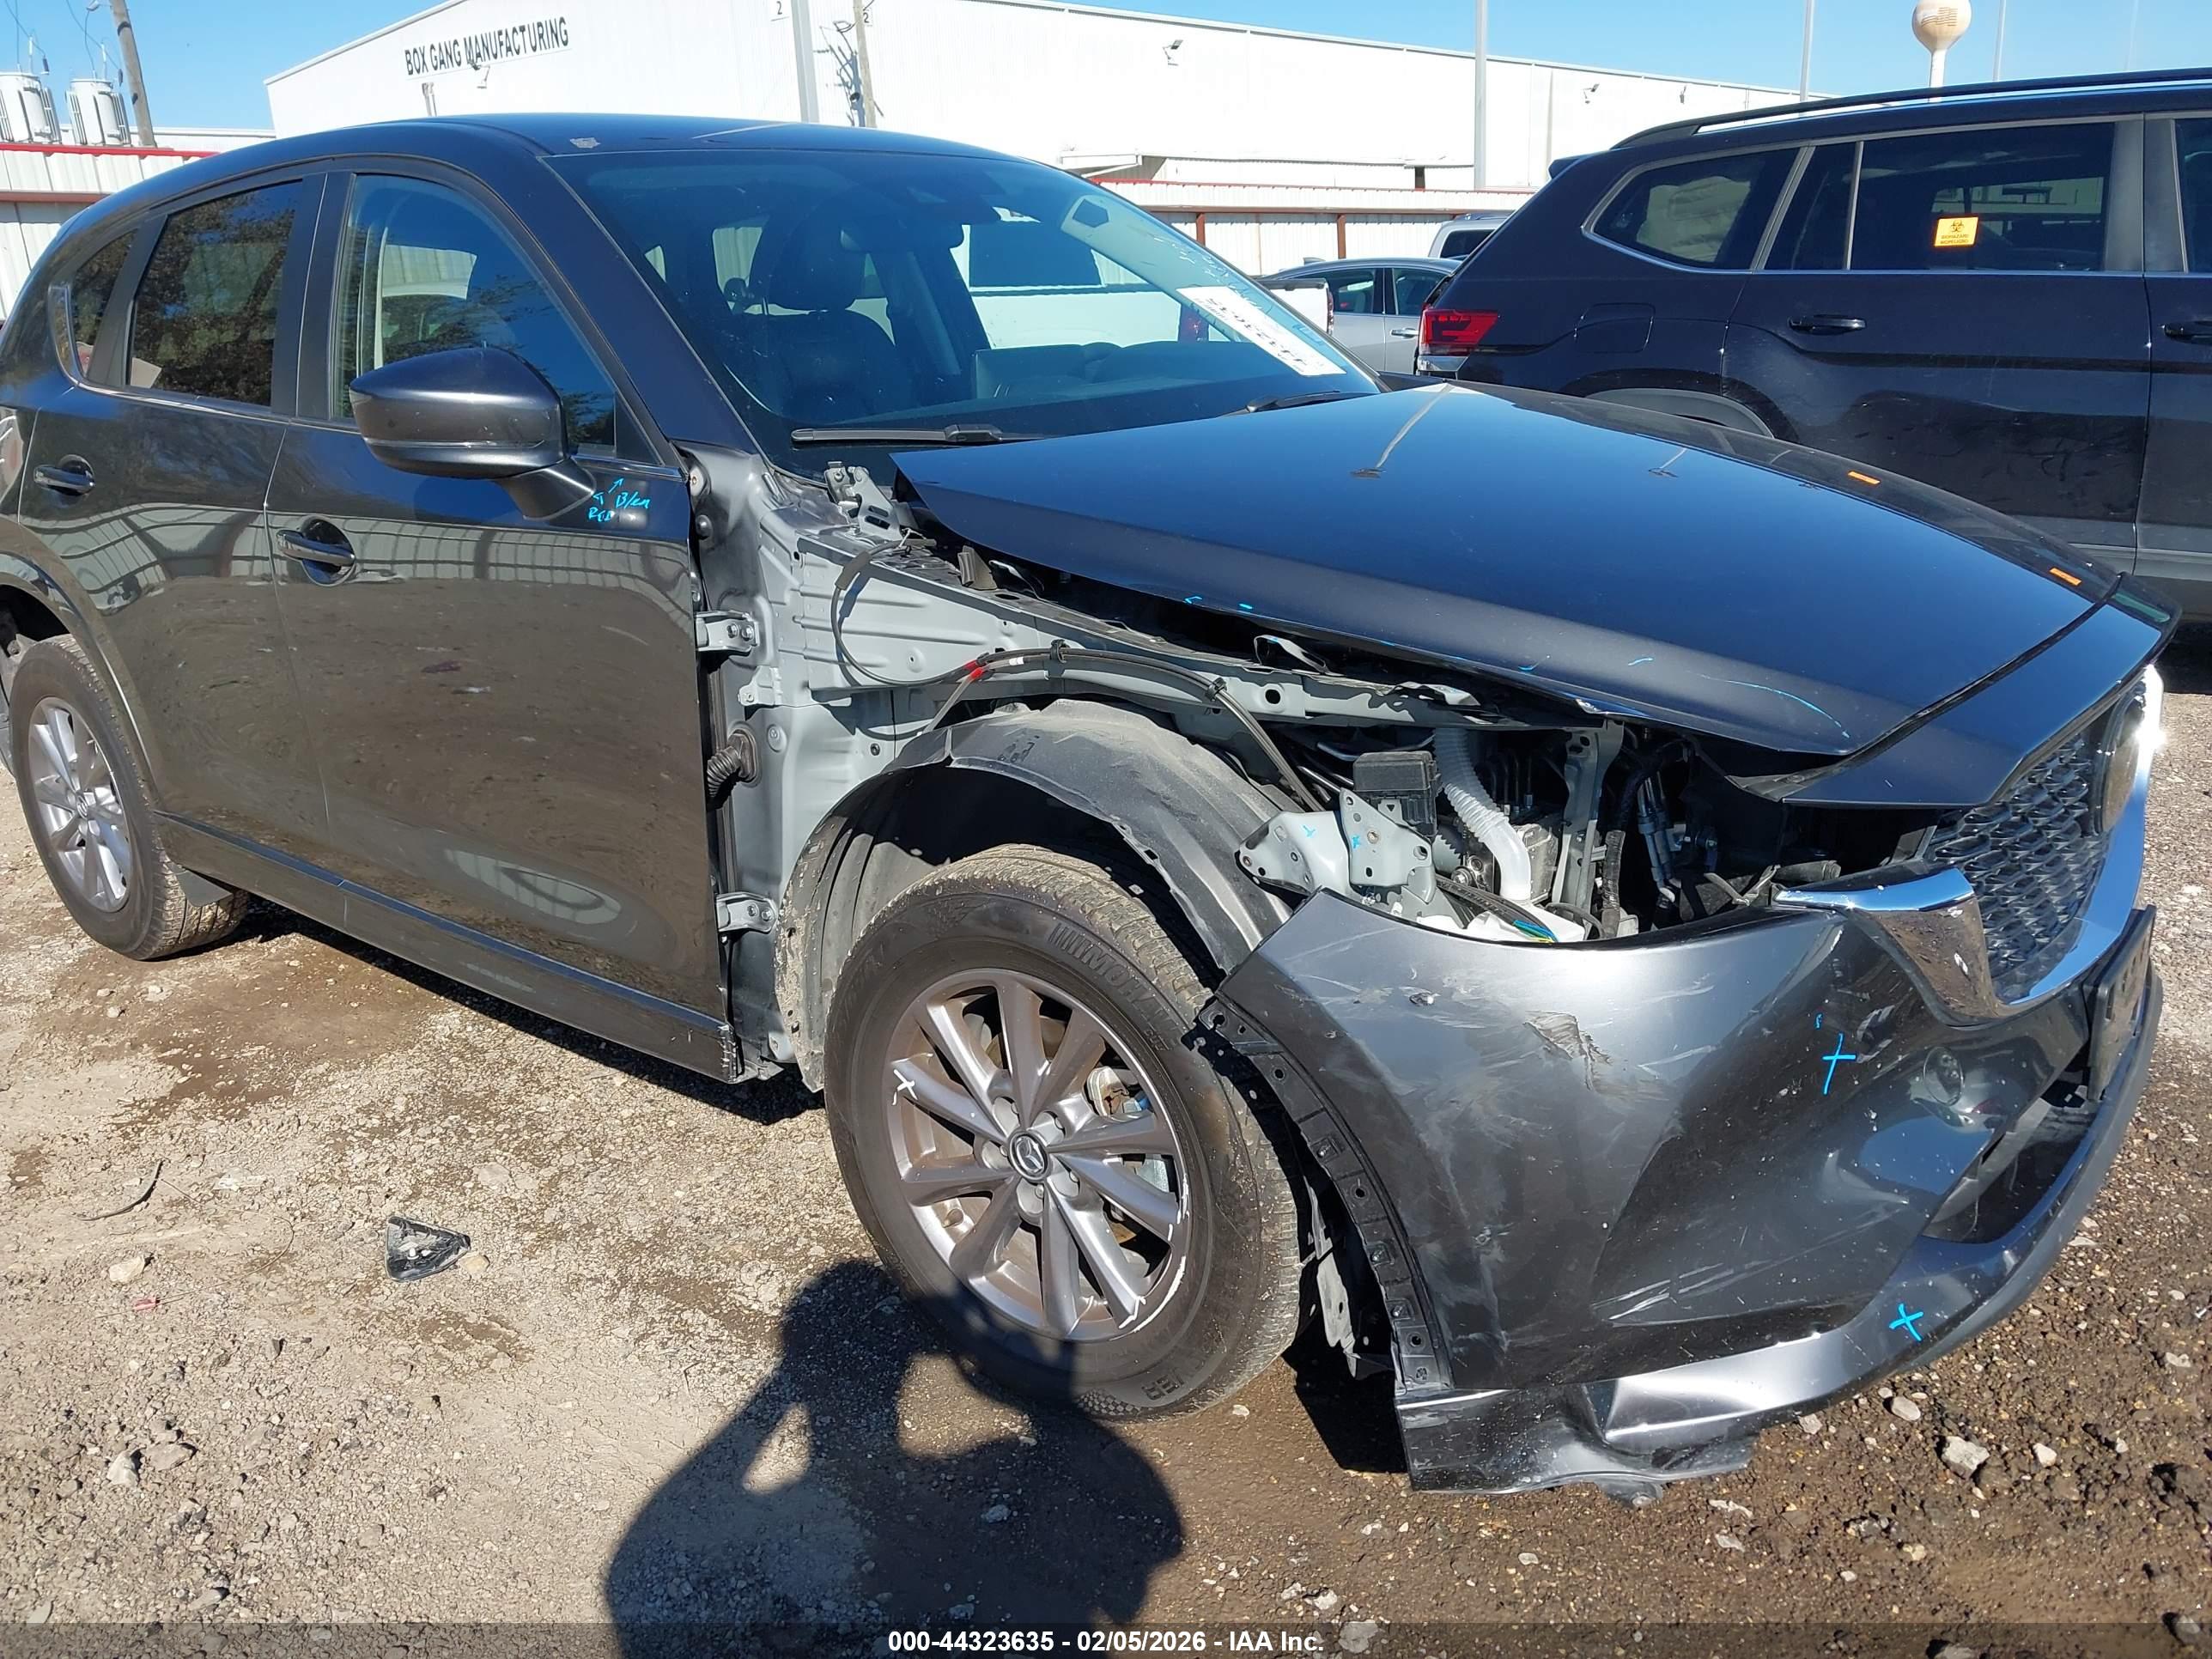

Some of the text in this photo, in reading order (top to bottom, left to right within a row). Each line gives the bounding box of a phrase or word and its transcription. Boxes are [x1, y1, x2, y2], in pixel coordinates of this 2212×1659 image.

[776, 1, 783, 15] 2
[863, 12, 870, 23] 2
[404, 16, 569, 76] BOX GANG MANUFACTURING
